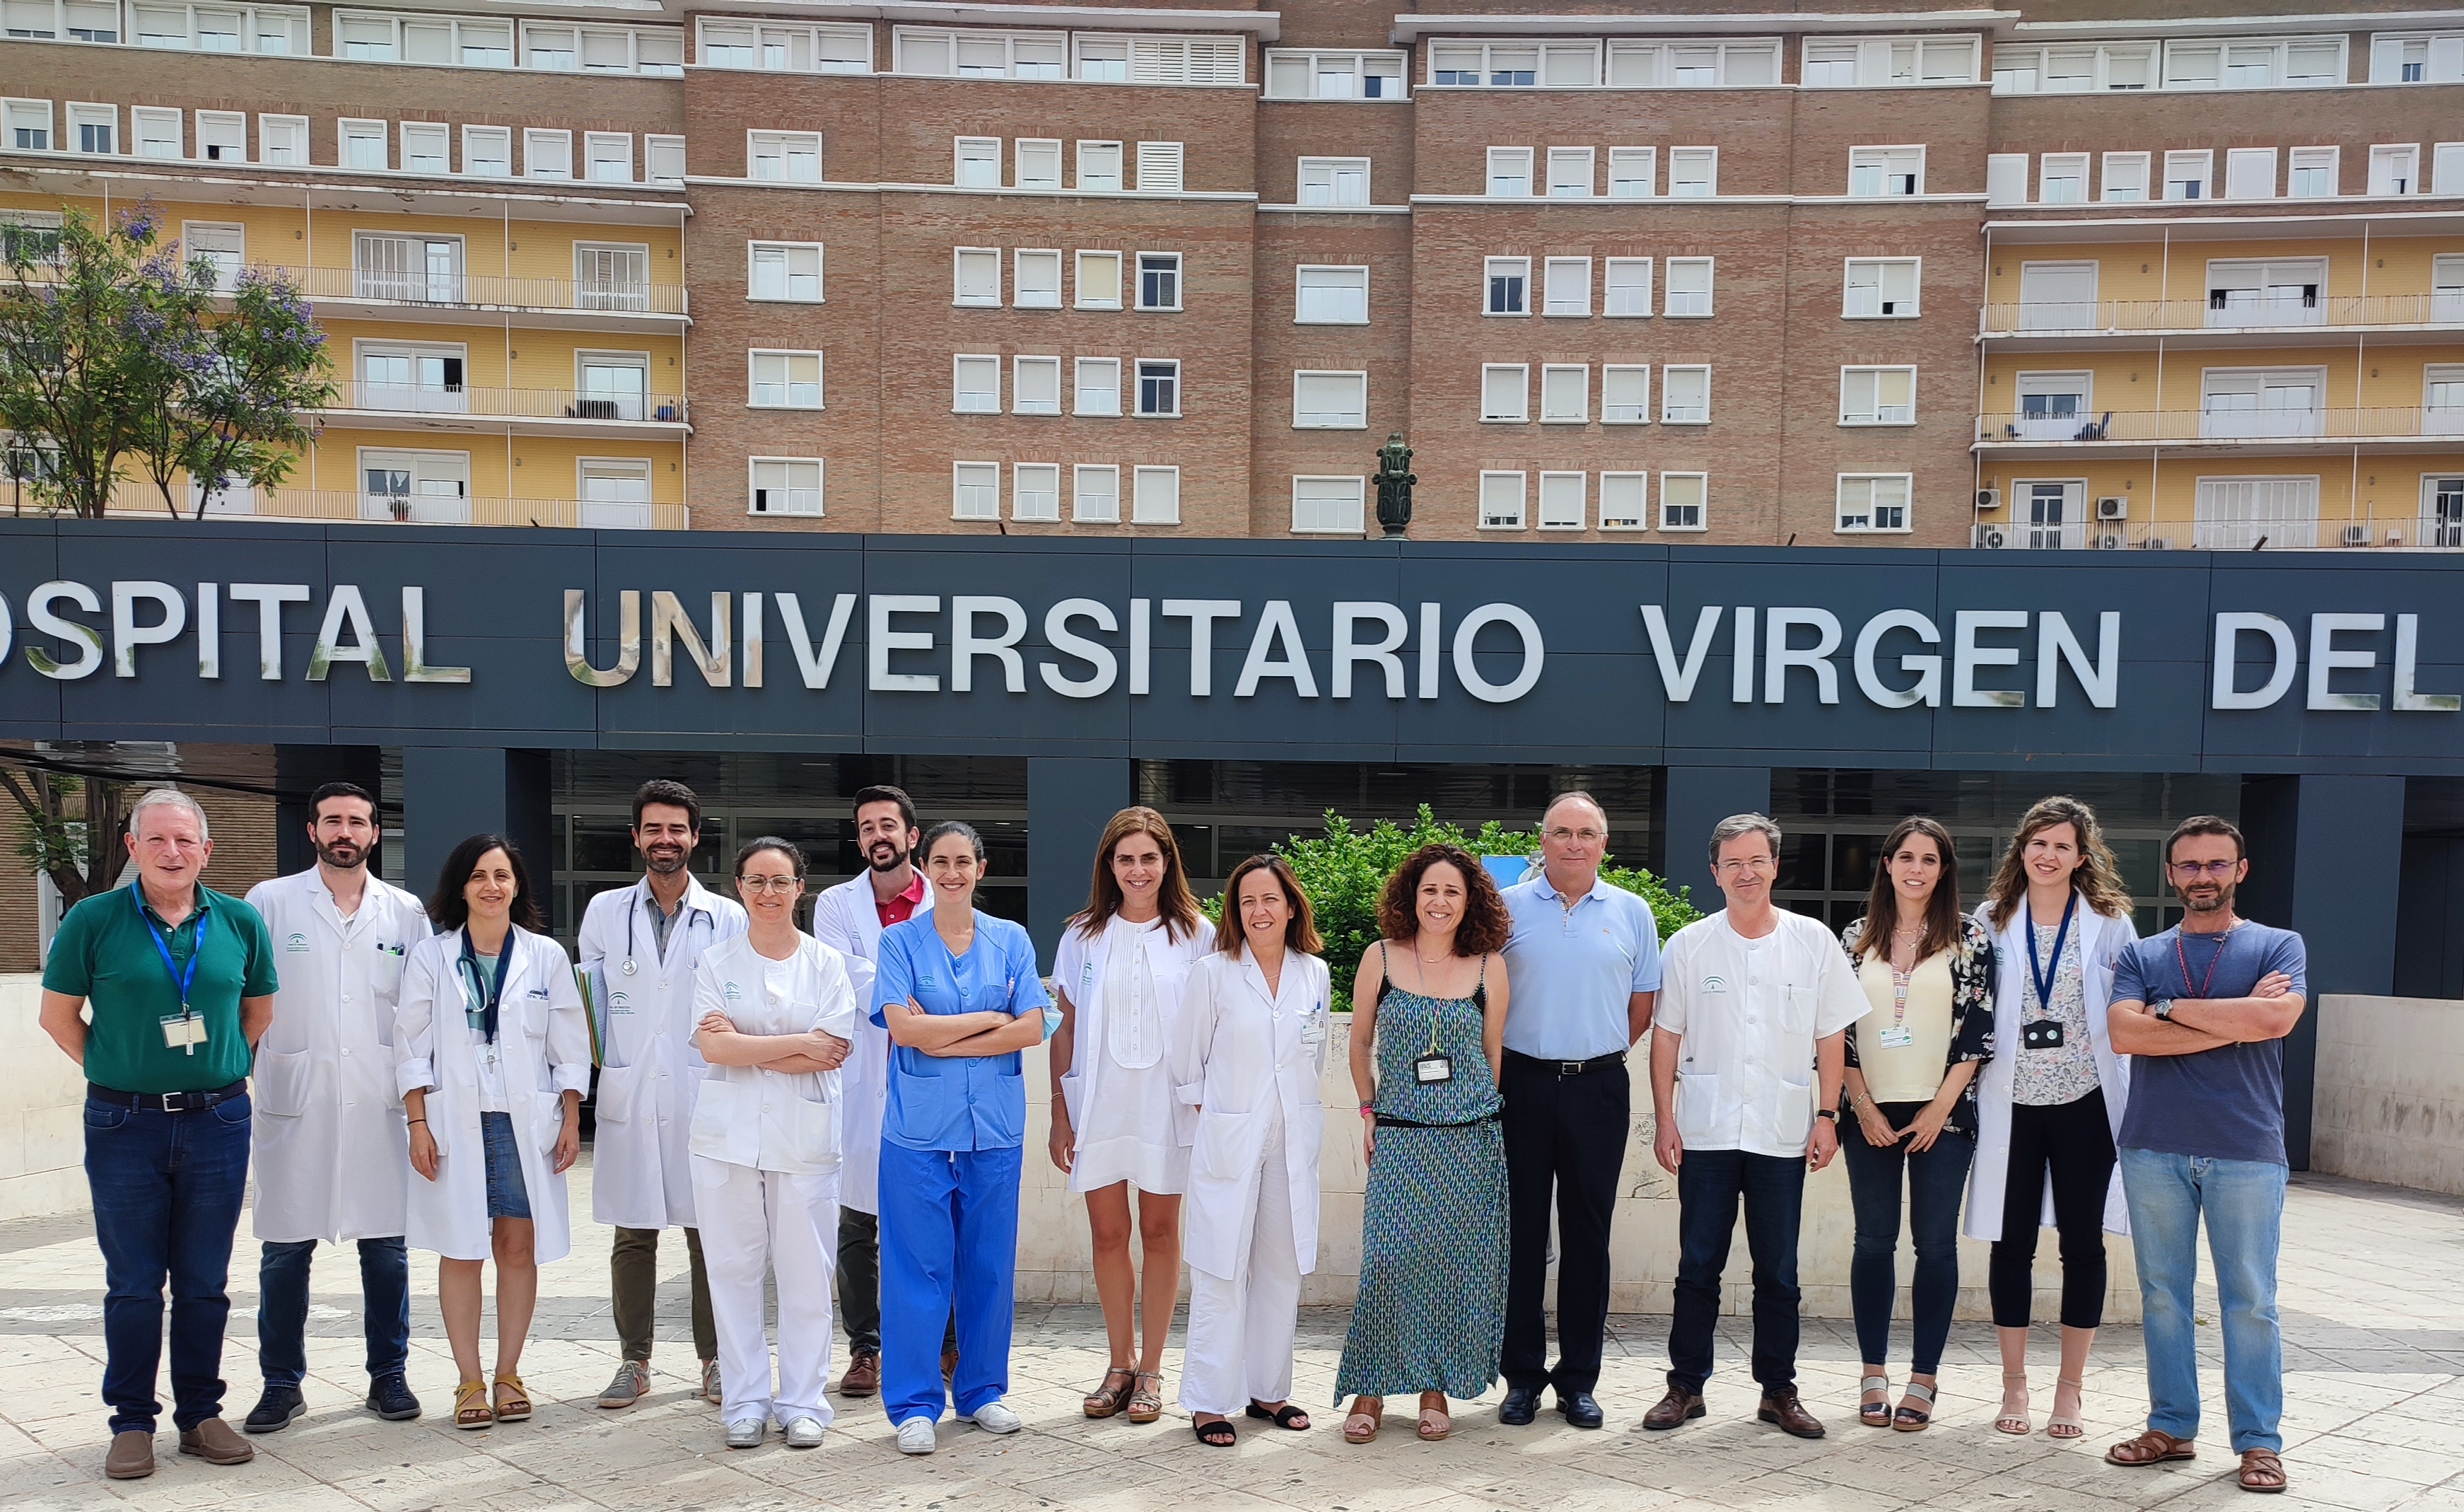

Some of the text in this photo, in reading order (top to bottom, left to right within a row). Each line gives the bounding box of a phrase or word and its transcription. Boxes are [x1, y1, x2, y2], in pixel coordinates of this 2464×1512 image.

[0, 580, 2462, 711] SPITAL UNIVERSITARIO VIRGEN DEL
